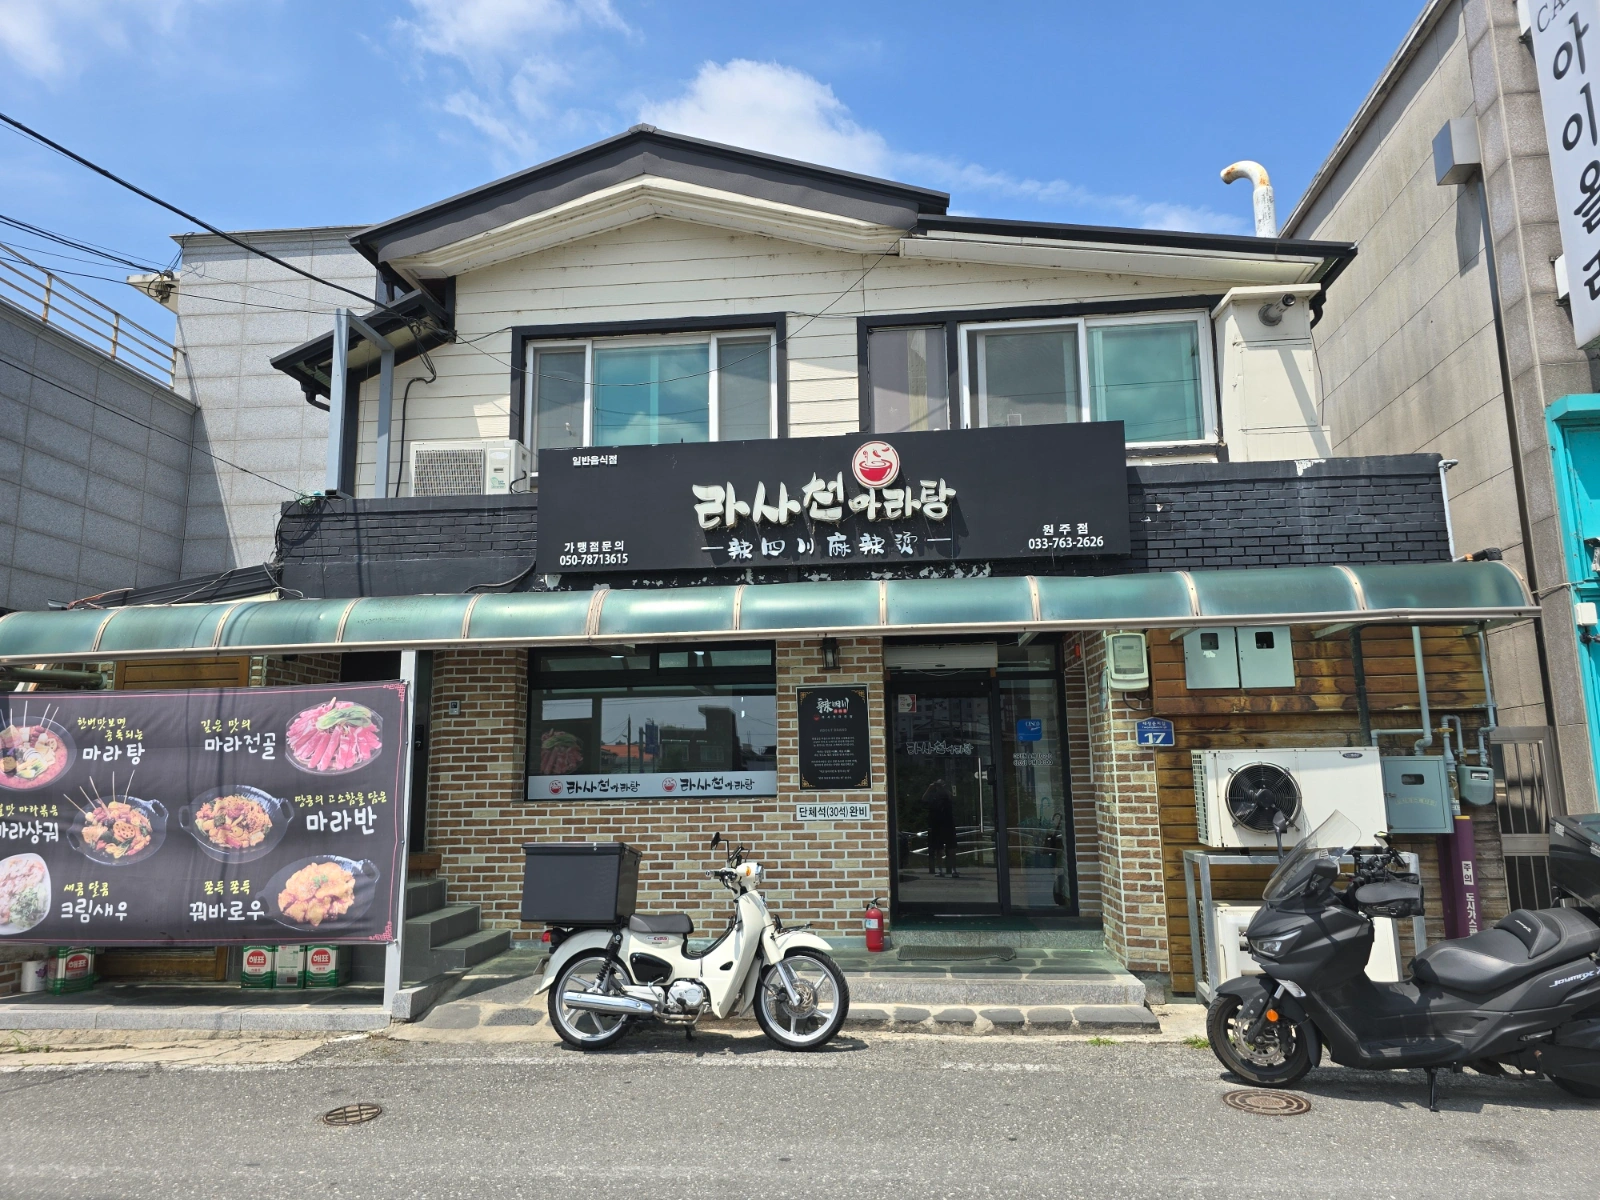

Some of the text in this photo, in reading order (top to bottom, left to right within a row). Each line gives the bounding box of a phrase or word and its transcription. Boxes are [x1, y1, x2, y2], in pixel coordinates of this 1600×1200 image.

[572, 454, 618, 466] 일반음식점
[1042, 522, 1089, 536] 원주점
[564, 539, 625, 553] 가맹점문의
[1028, 536, 1104, 549] 033-763-2626
[559, 552, 629, 567] 050-78713615
[201, 717, 251, 734] 깊은 맛의
[104, 729, 143, 742] 중독되는
[1144, 732, 1166, 744] 17
[204, 732, 276, 760] 마라전골
[82, 742, 146, 765] 마라탕
[294, 790, 387, 807] 땅콩의 고소함을 담은
[19, 804, 59, 818] 마라볶음
[799, 806, 868, 818] 단체석(30석)완비
[306, 805, 377, 835] 마라반
[1463, 863, 1473, 883] 주의
[63, 881, 109, 898] 새콤 달콤
[204, 880, 250, 895] 쫀득 쫀득
[61, 898, 128, 923] 크림새우
[189, 900, 265, 922] 꿔바로우
[68, 959, 87, 968] 해표
[249, 955, 265, 964] 해표
[312, 954, 329, 963] 해표
